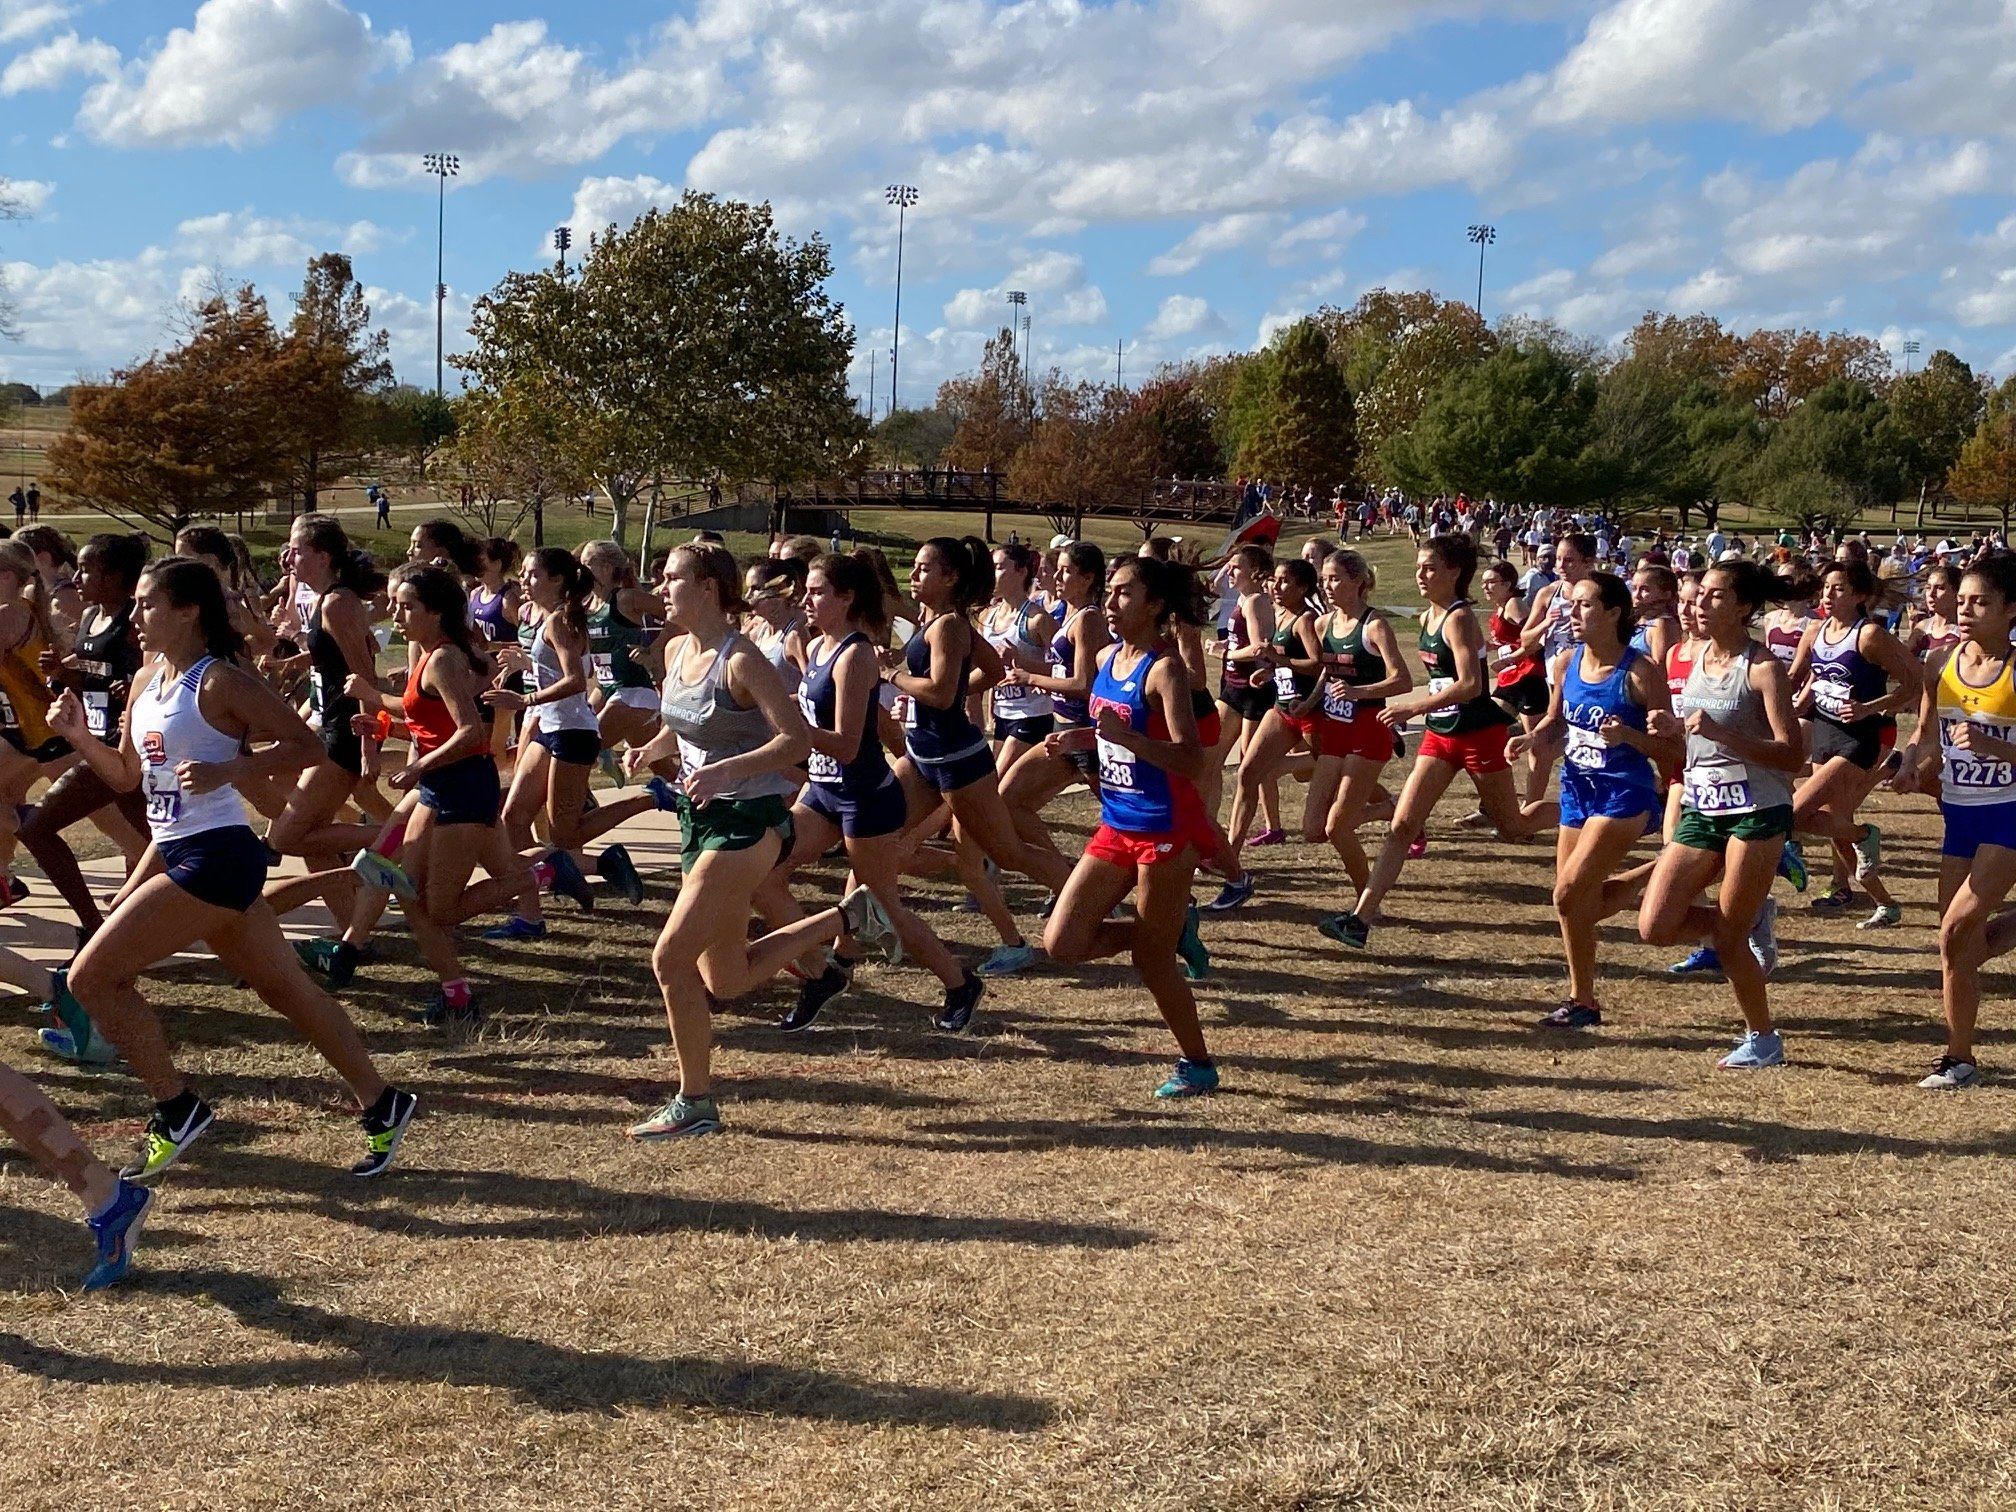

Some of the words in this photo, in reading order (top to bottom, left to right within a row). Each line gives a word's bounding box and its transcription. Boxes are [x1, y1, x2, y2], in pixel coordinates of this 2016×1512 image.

[1324, 696, 1353, 716] 2343
[1956, 762, 2012, 785] 2273
[1695, 784, 1747, 810] 2349
